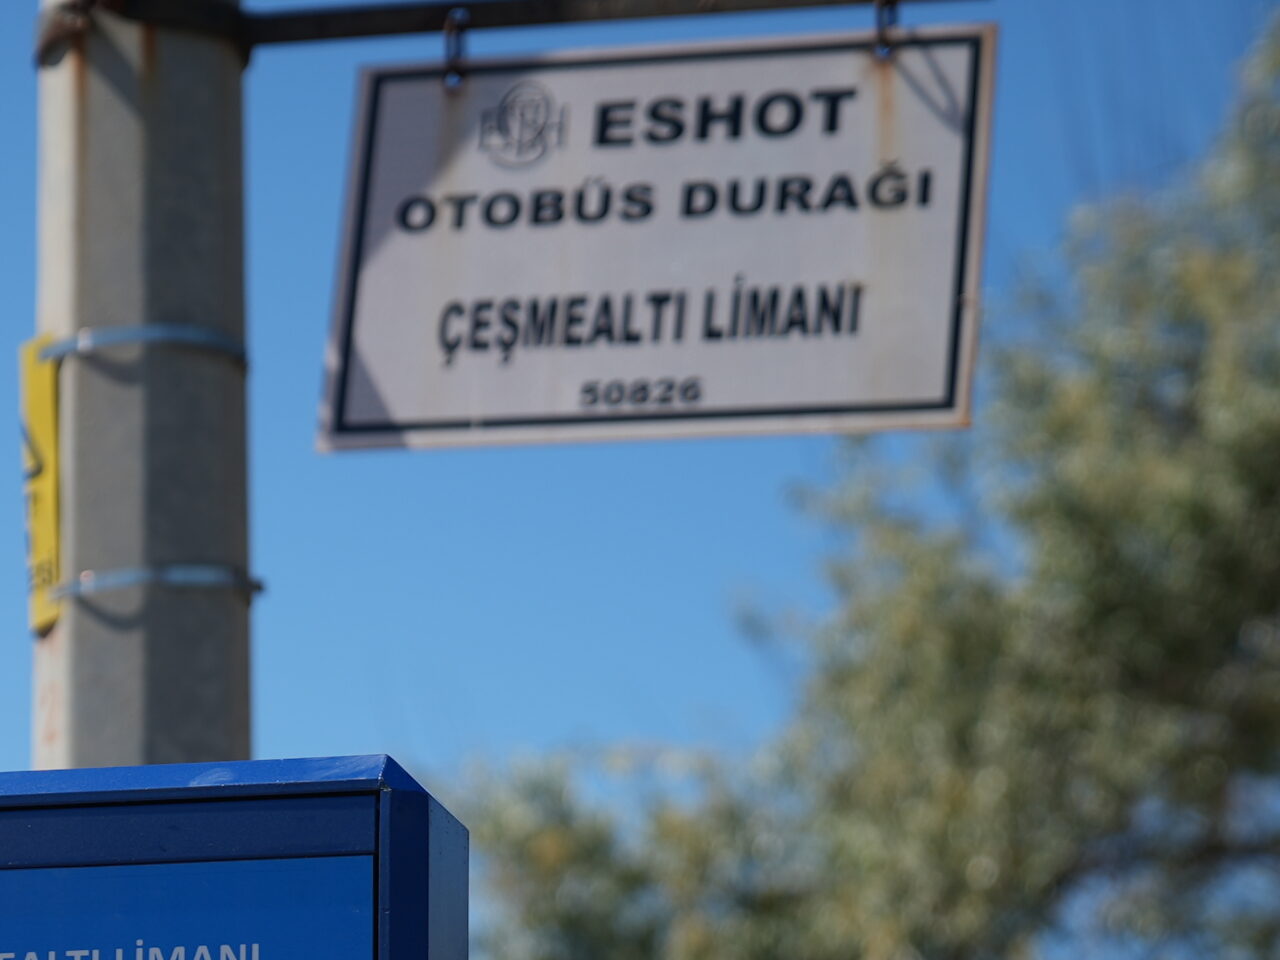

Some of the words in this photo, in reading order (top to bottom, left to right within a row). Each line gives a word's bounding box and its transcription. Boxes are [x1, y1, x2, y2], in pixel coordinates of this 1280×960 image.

[593, 89, 857, 147] ESHOT
[396, 176, 655, 233] OTOBÜS
[680, 160, 933, 219] DURAĞI
[439, 291, 687, 366] ÇEŞMEALTI
[702, 274, 862, 341] LİMANI
[580, 378, 704, 409] 50826
